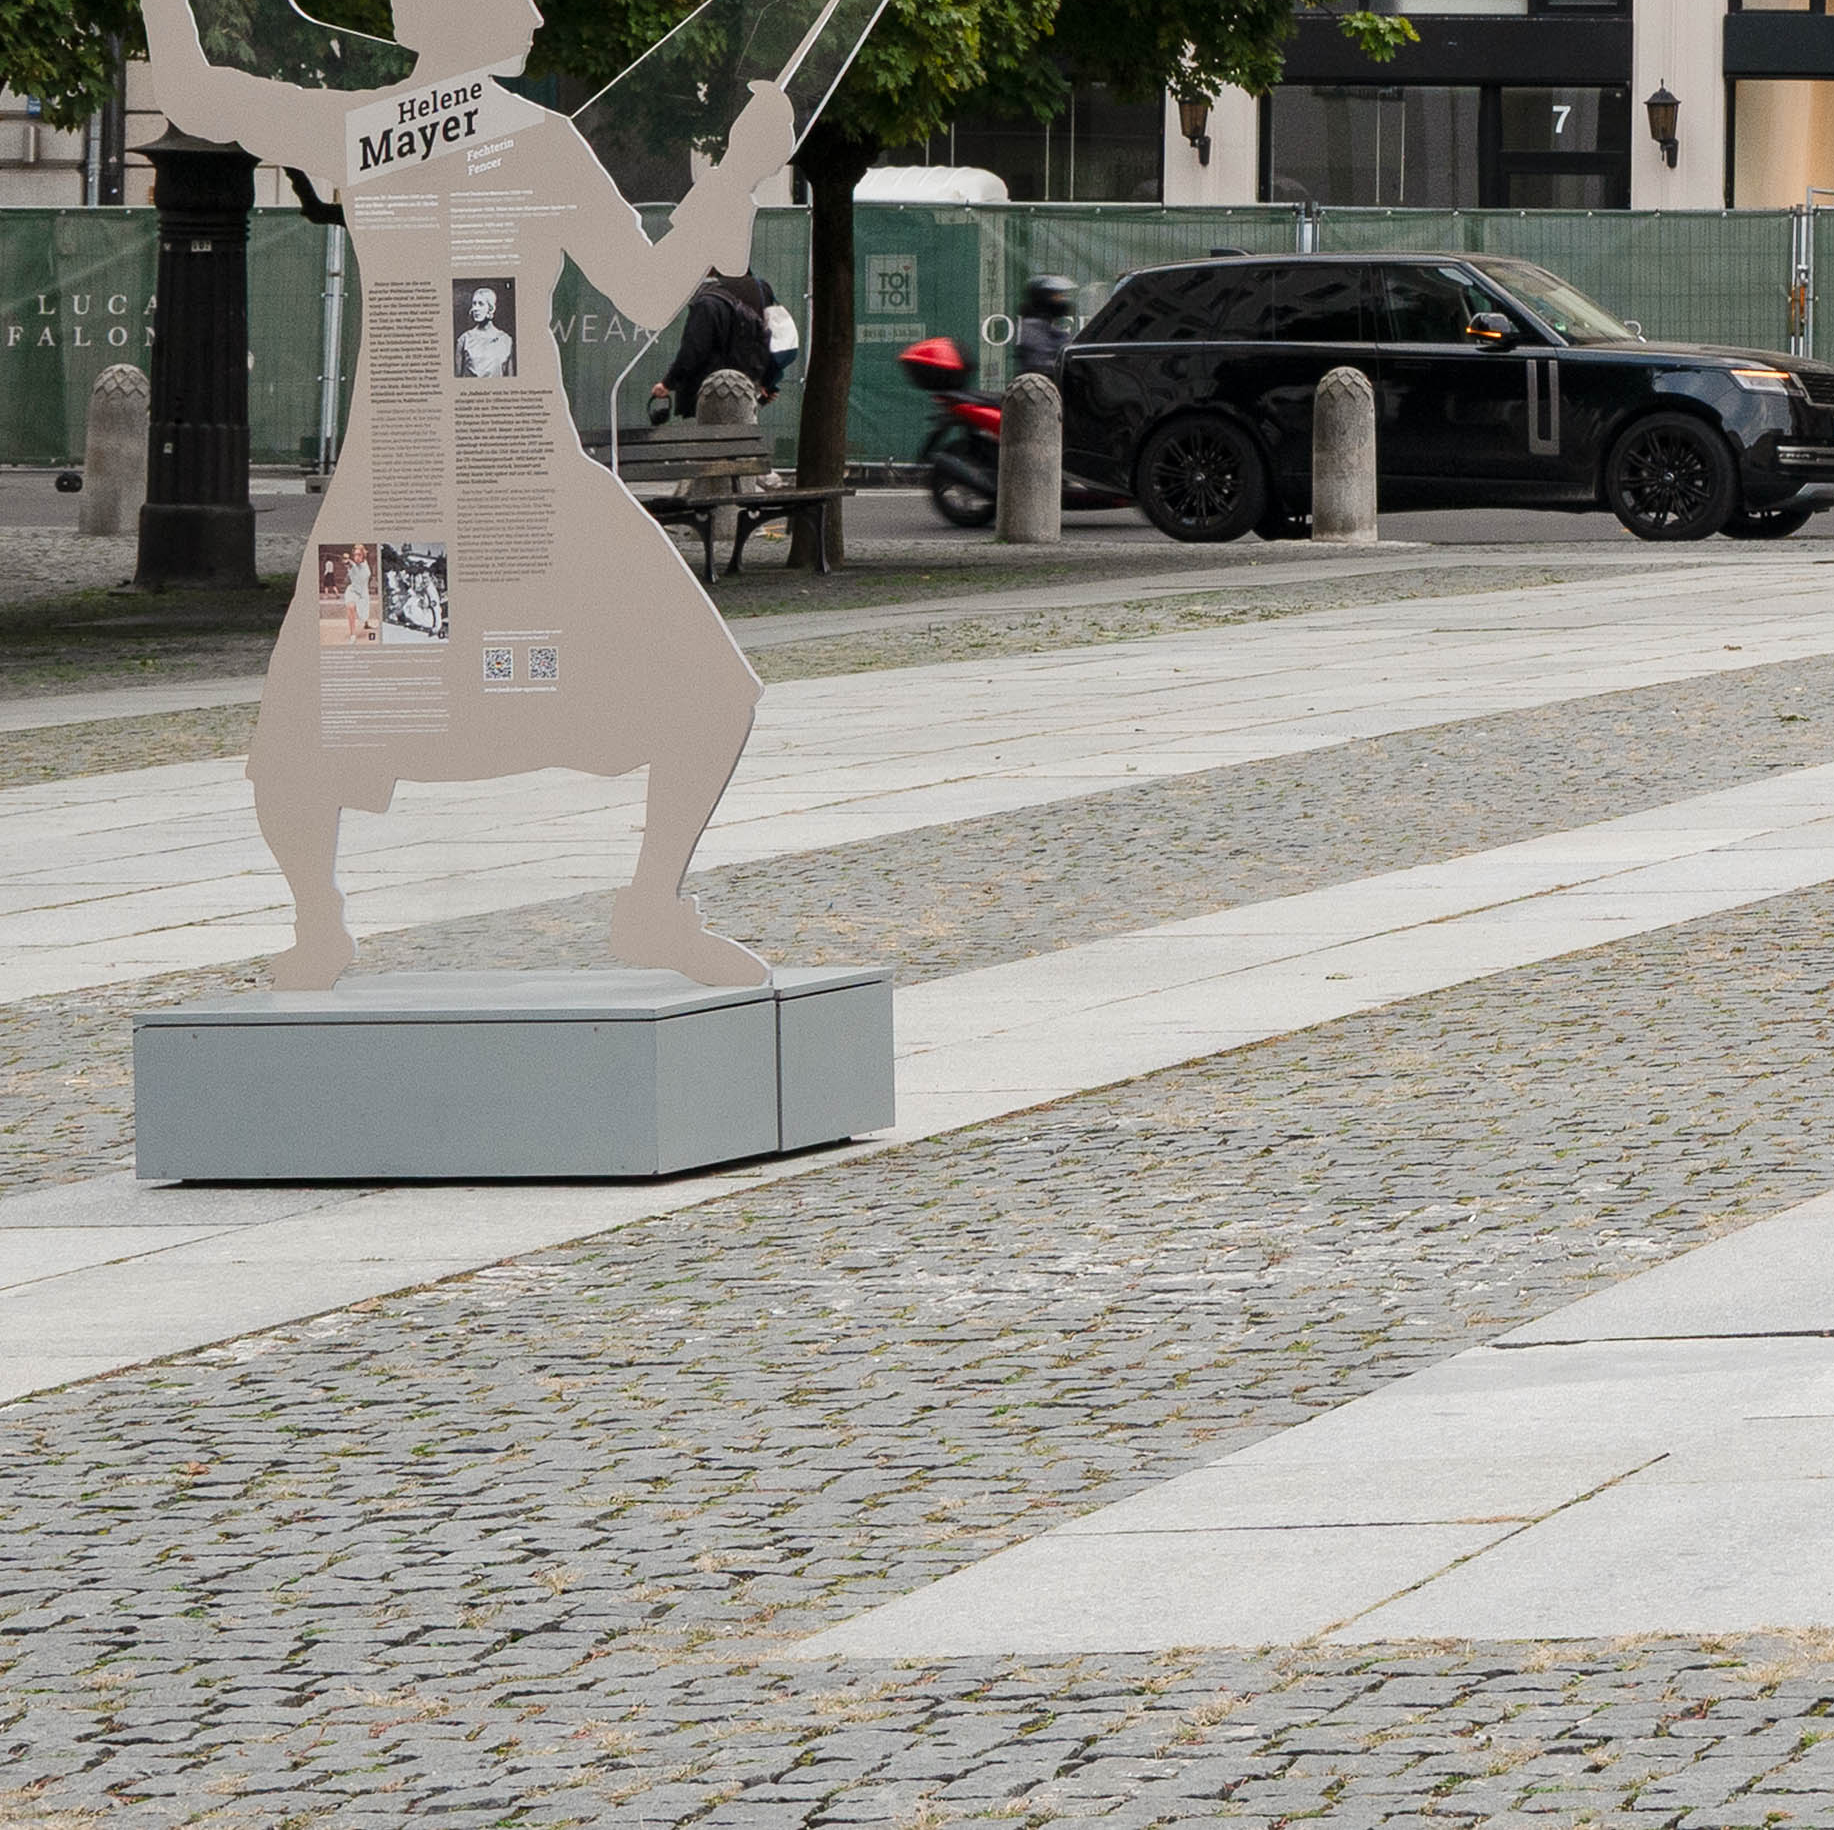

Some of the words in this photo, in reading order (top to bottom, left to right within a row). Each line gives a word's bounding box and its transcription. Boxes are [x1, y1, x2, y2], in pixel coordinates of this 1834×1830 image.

[397, 82, 483, 125] Helene
[1551, 104, 1571, 133] 7
[359, 107, 480, 171] Mayer
[466, 137, 515, 162] Fechterin
[467, 157, 503, 176] Fencer
